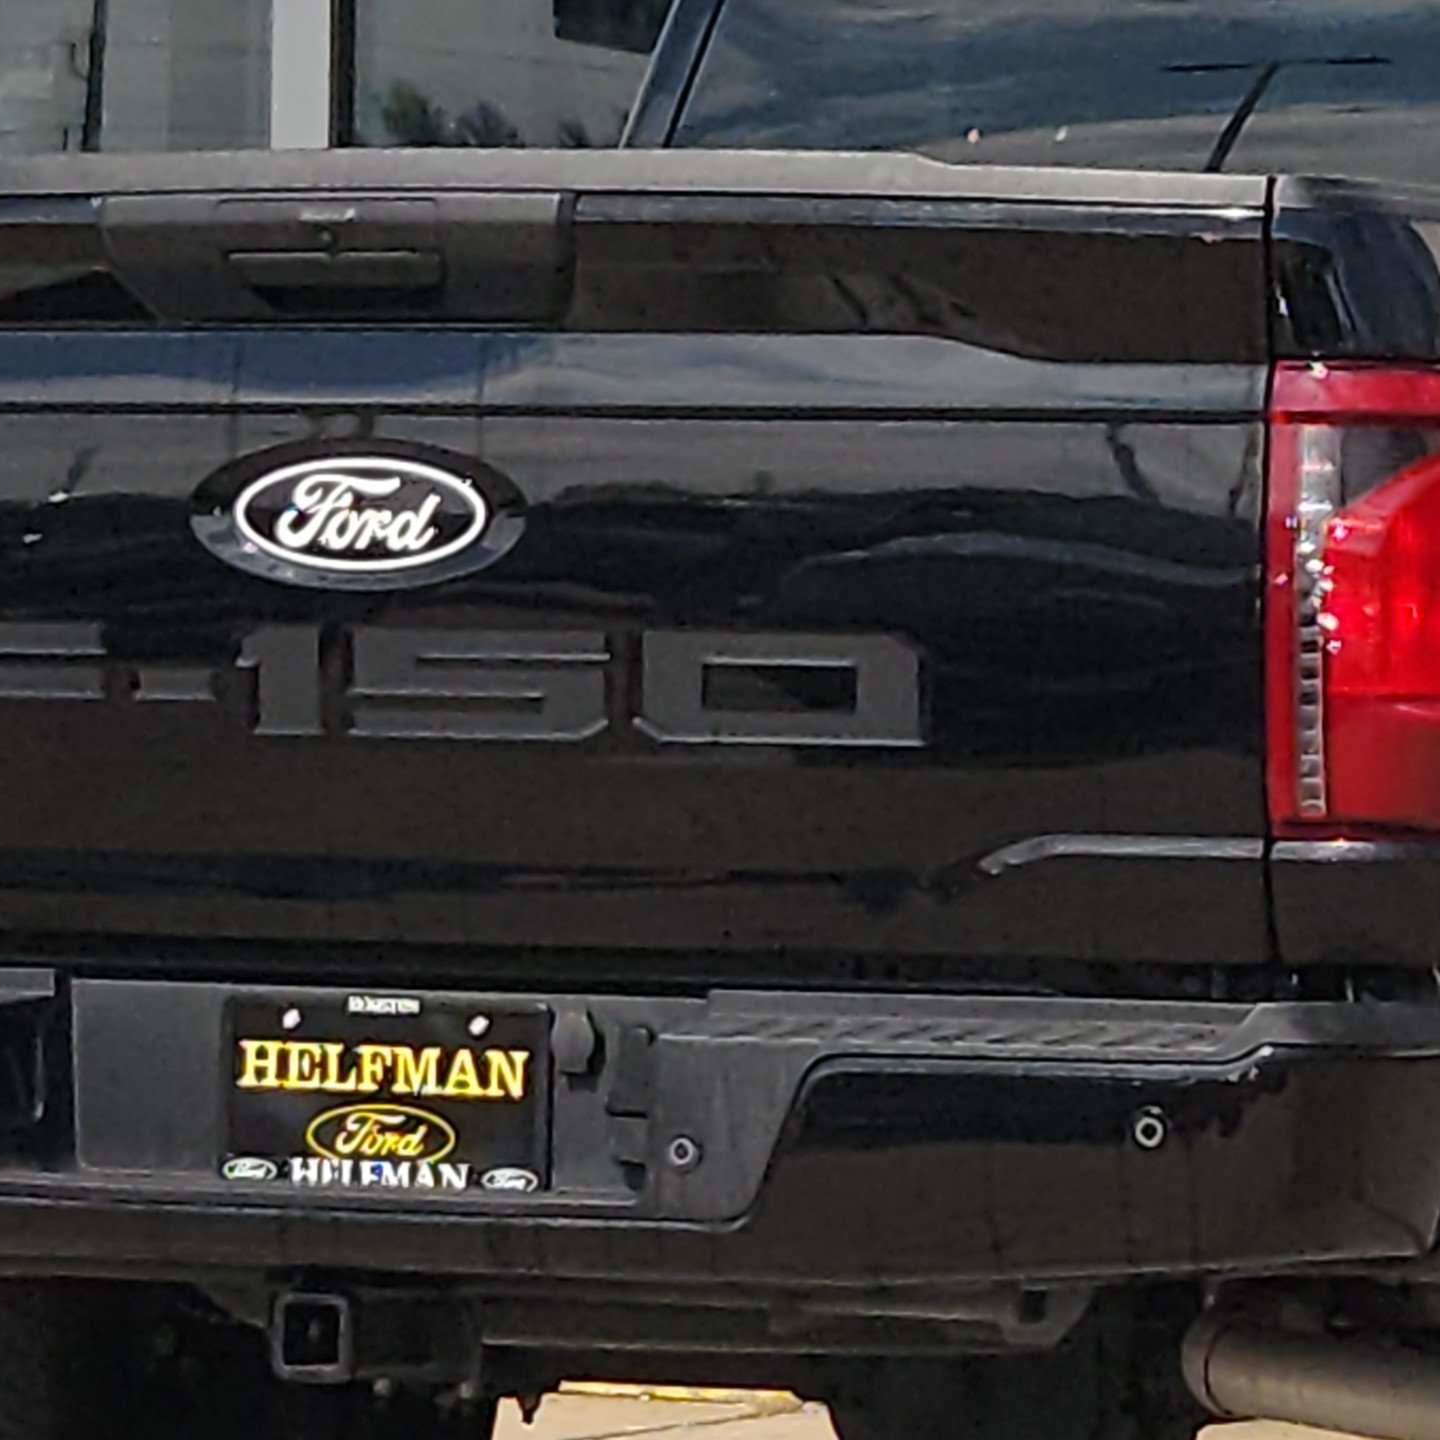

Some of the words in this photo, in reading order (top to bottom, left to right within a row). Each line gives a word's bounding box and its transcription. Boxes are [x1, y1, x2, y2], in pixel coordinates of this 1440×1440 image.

[275, 473, 441, 551] Ford
[236, 1039, 530, 1100] HELFMAN
[335, 1112, 428, 1157] Ford
